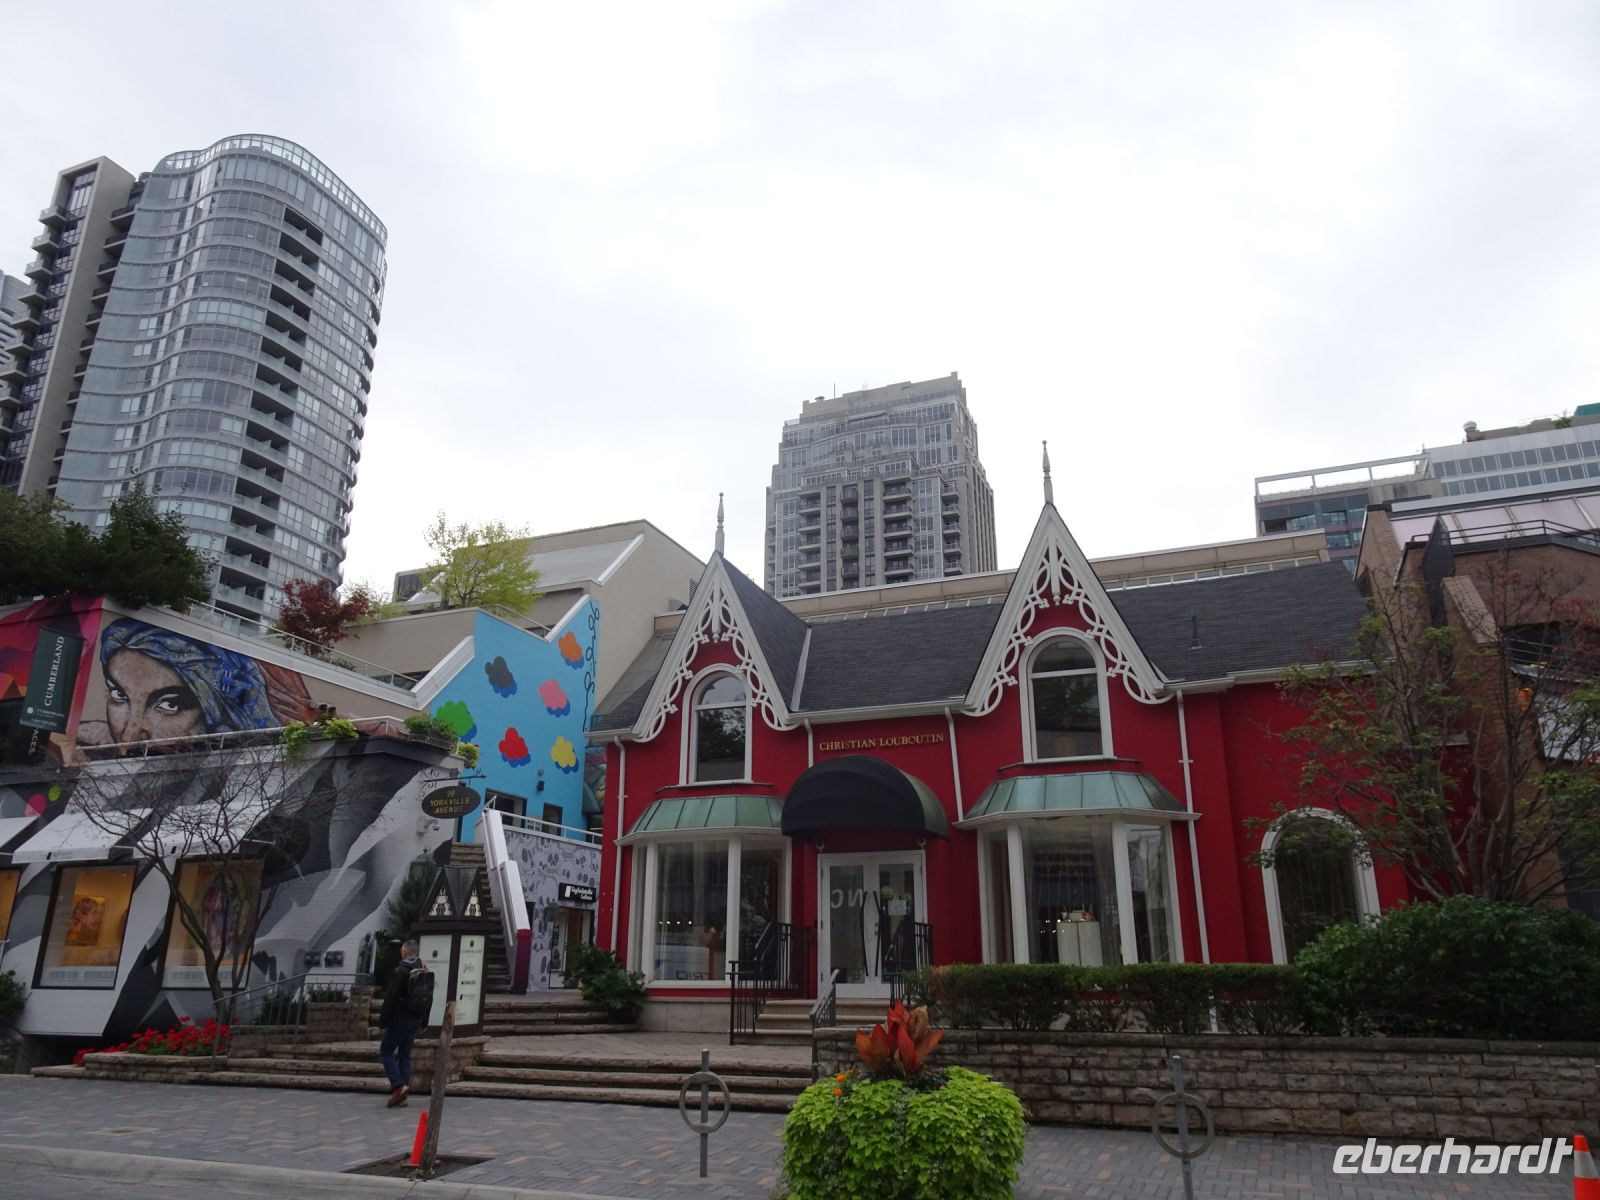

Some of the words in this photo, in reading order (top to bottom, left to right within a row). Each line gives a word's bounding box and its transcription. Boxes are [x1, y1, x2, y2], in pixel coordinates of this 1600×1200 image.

[44, 636, 65, 706] CUMBERLAND
[819, 738, 876, 751] CHRISTIAN
[879, 733, 944, 747] LOUBOUTIN
[430, 797, 470, 807] YORKVILLE
[434, 804, 464, 814] AVENUE
